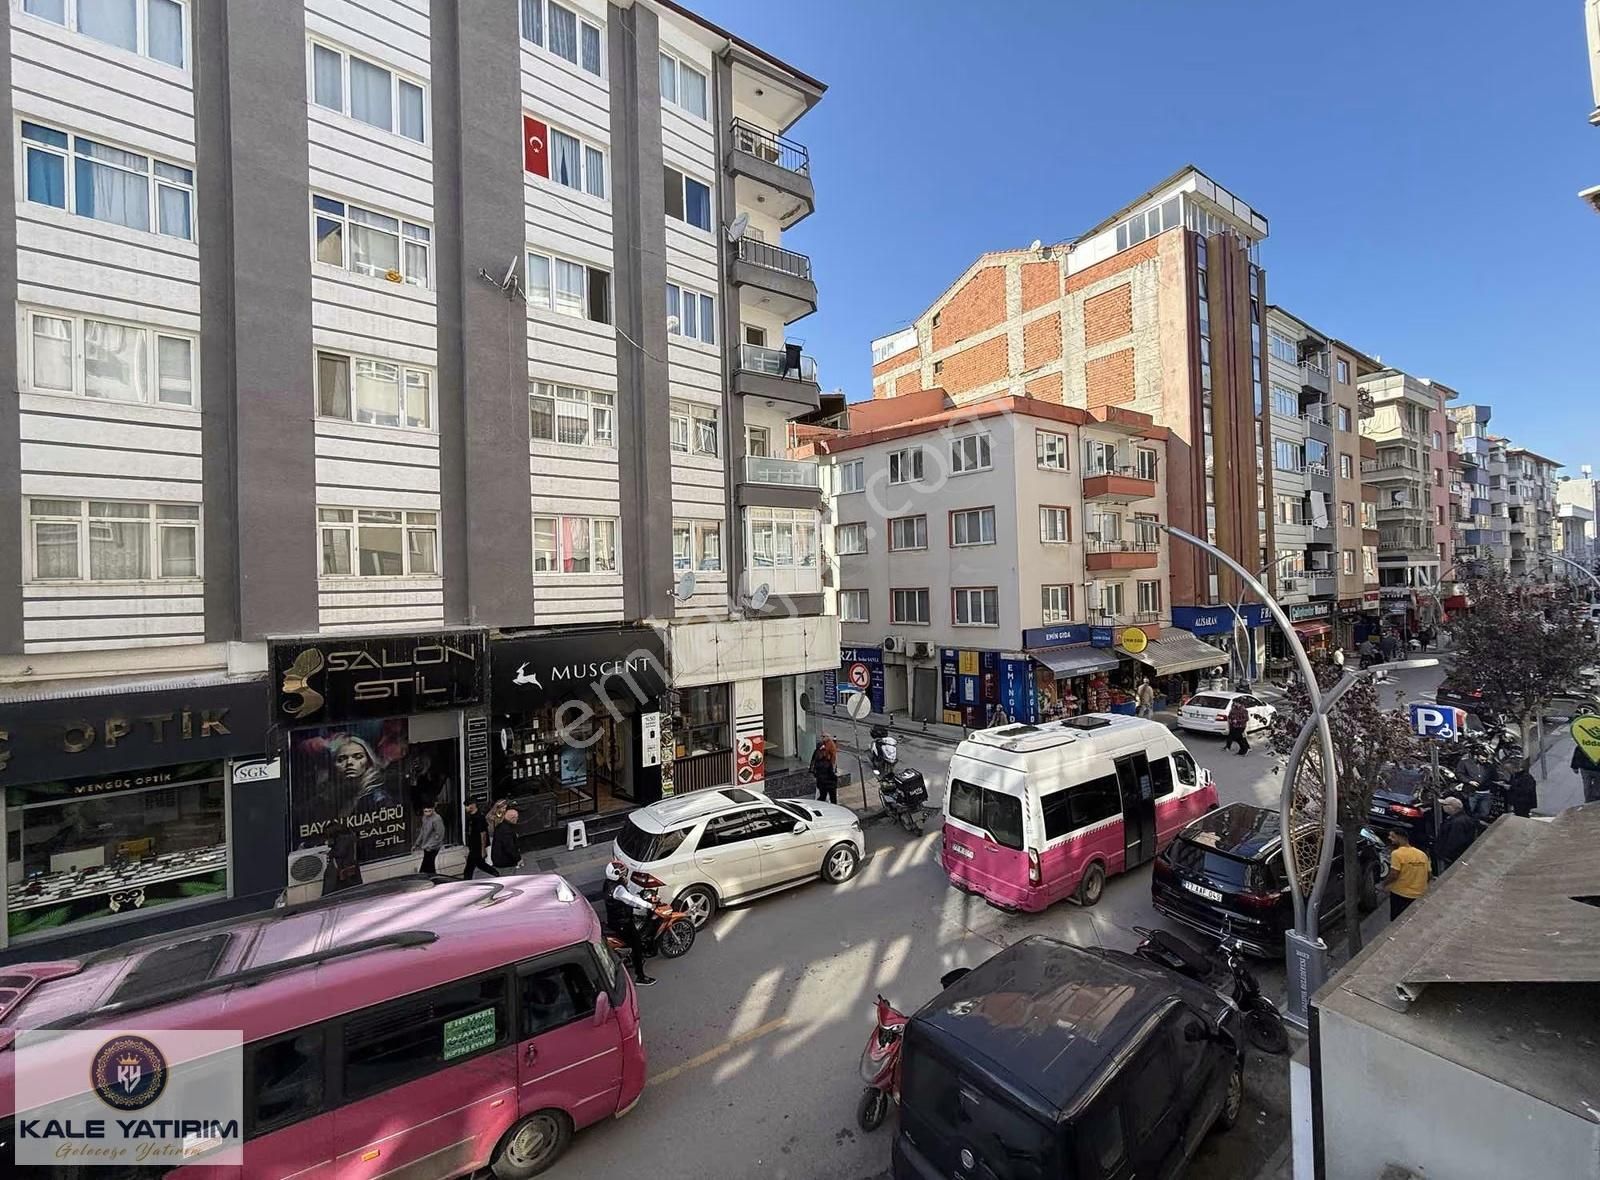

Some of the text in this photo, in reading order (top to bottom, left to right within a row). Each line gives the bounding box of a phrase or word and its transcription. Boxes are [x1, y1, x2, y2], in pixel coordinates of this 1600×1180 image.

[327, 643, 475, 672] SALON
[840, 649, 857, 661] RZİ
[551, 657, 651, 681] MUSCENT
[354, 671, 447, 700] STİL
[63, 705, 232, 753] OPTİK
[1416, 708, 1444, 735] P
[73, 773, 172, 794] MENGÜÇ OPTİK
[239, 765, 269, 778] SGK
[299, 804, 404, 838] BAY KUAFÖRÜ
[359, 822, 406, 839] SALON
[375, 835, 406, 848] STİL
